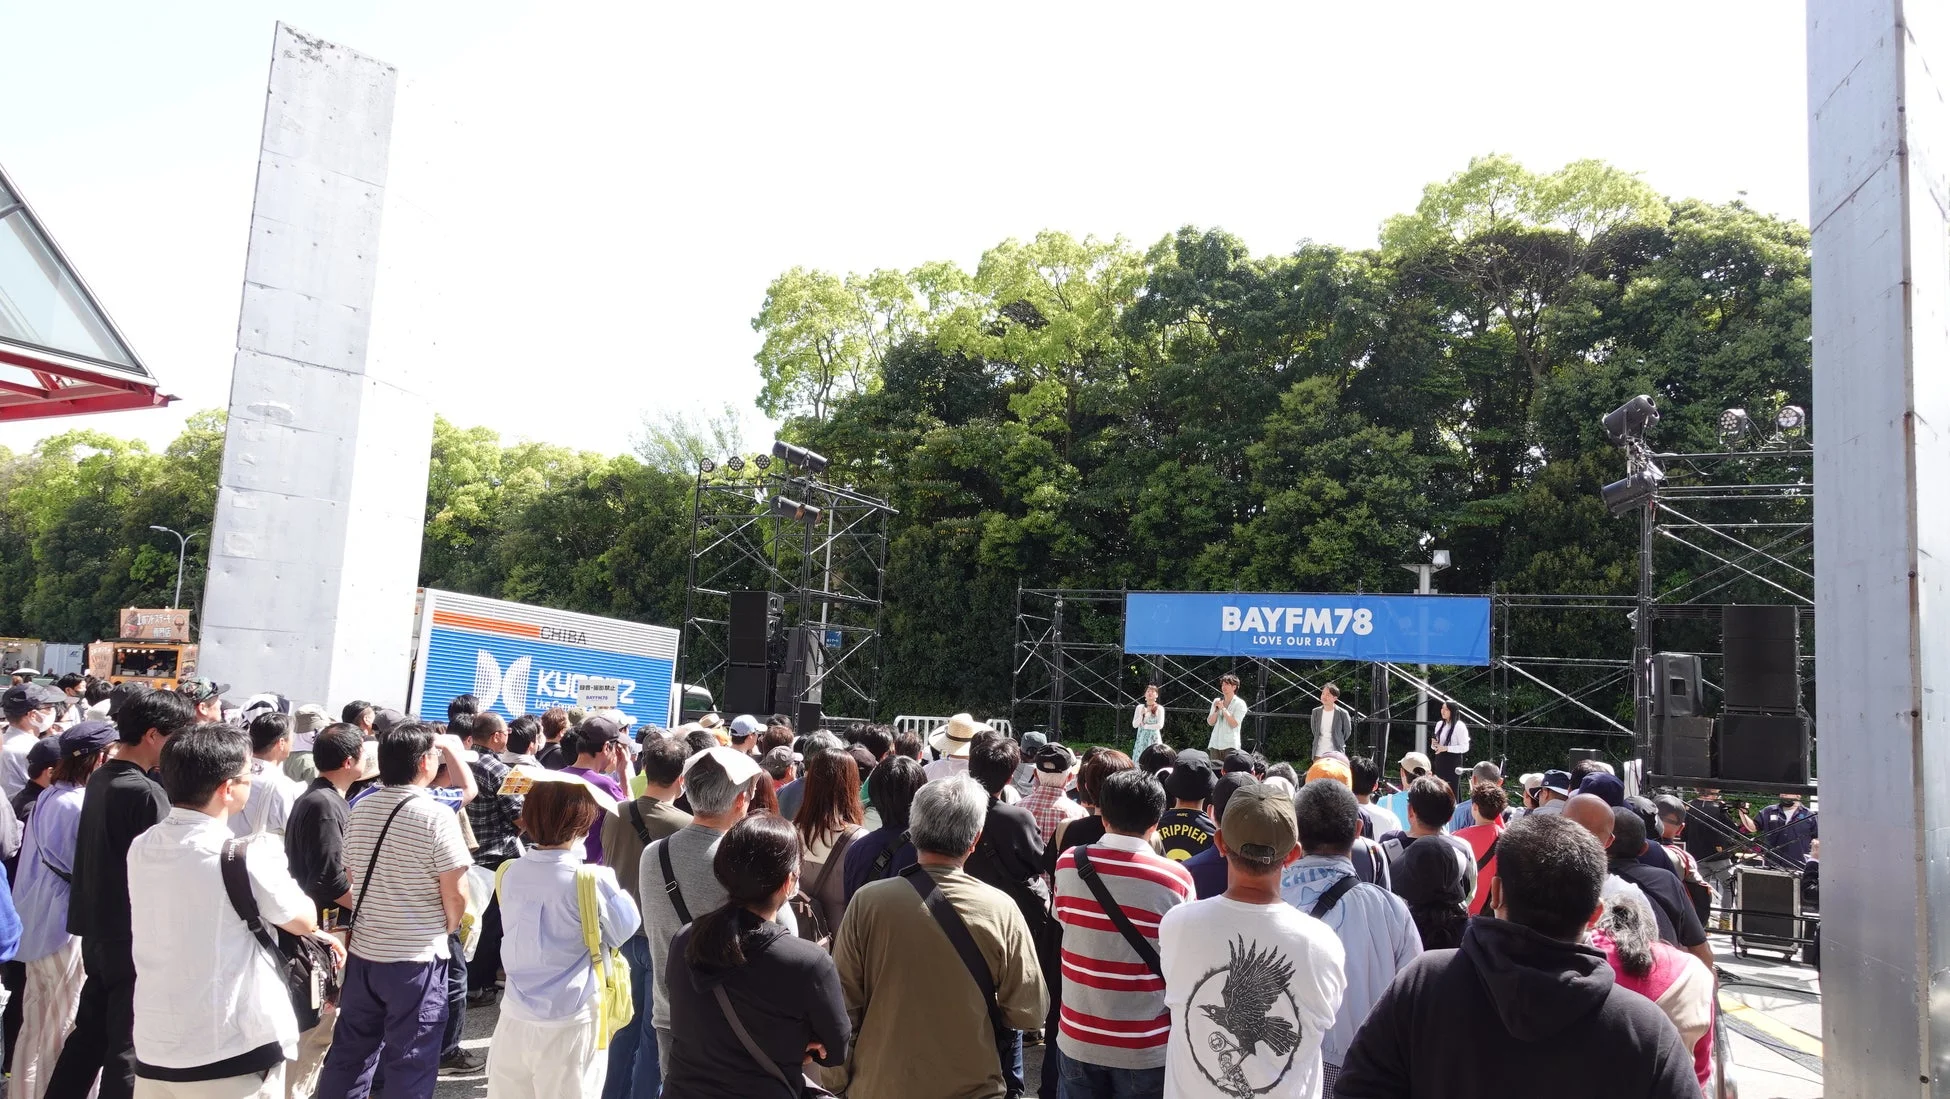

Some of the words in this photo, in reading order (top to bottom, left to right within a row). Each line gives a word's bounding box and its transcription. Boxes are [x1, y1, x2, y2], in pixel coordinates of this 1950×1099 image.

[1222, 606, 1374, 636] BAYFM78
[541, 626, 587, 645] CHIBA
[1253, 635, 1282, 645] LOVE
[1286, 637, 1311, 646] OUR
[1316, 637, 1338, 647] BAY
